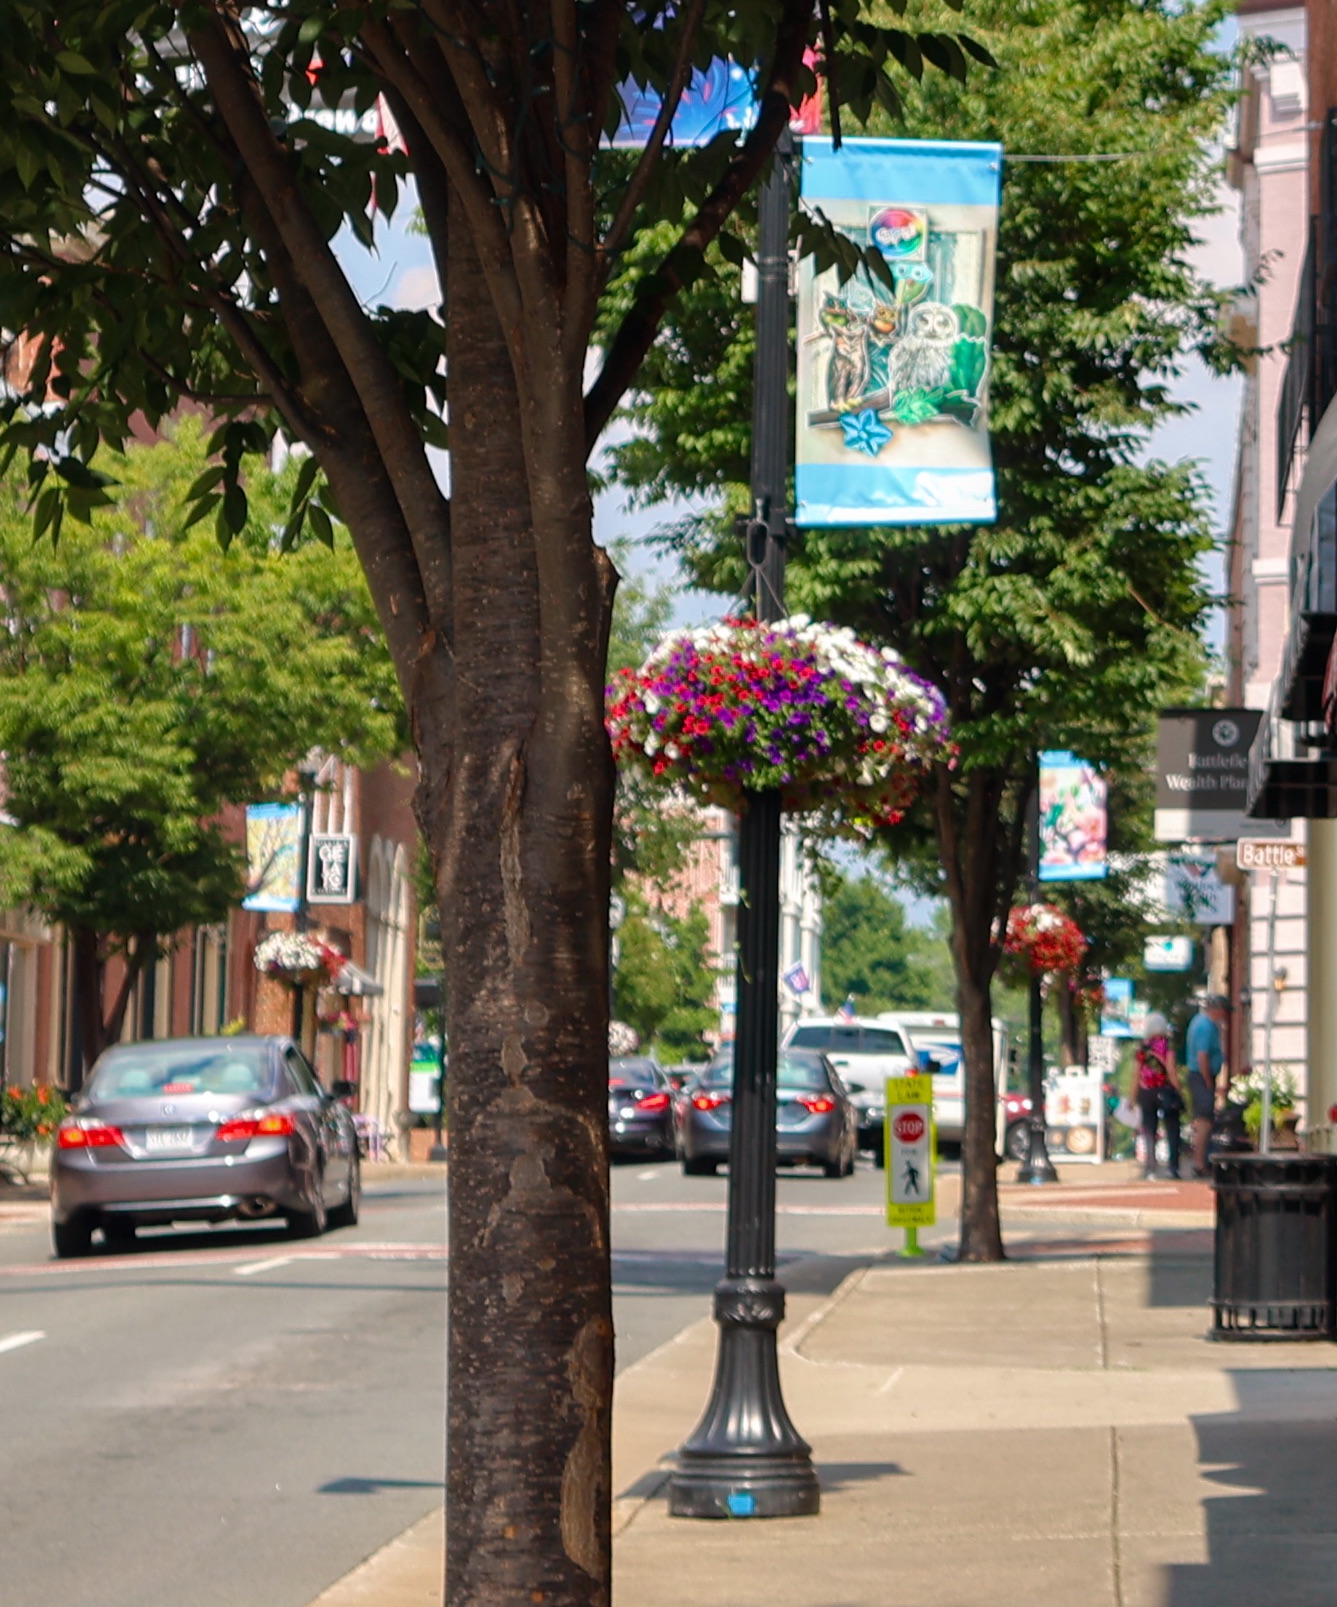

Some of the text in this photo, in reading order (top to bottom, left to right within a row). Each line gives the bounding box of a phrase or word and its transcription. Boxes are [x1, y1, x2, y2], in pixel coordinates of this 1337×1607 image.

[1188, 752, 1247, 769] Battlefie
[1165, 773, 1217, 791] Wealth
[1243, 844, 1295, 865] Battle
[894, 1120, 924, 1134] STOP
